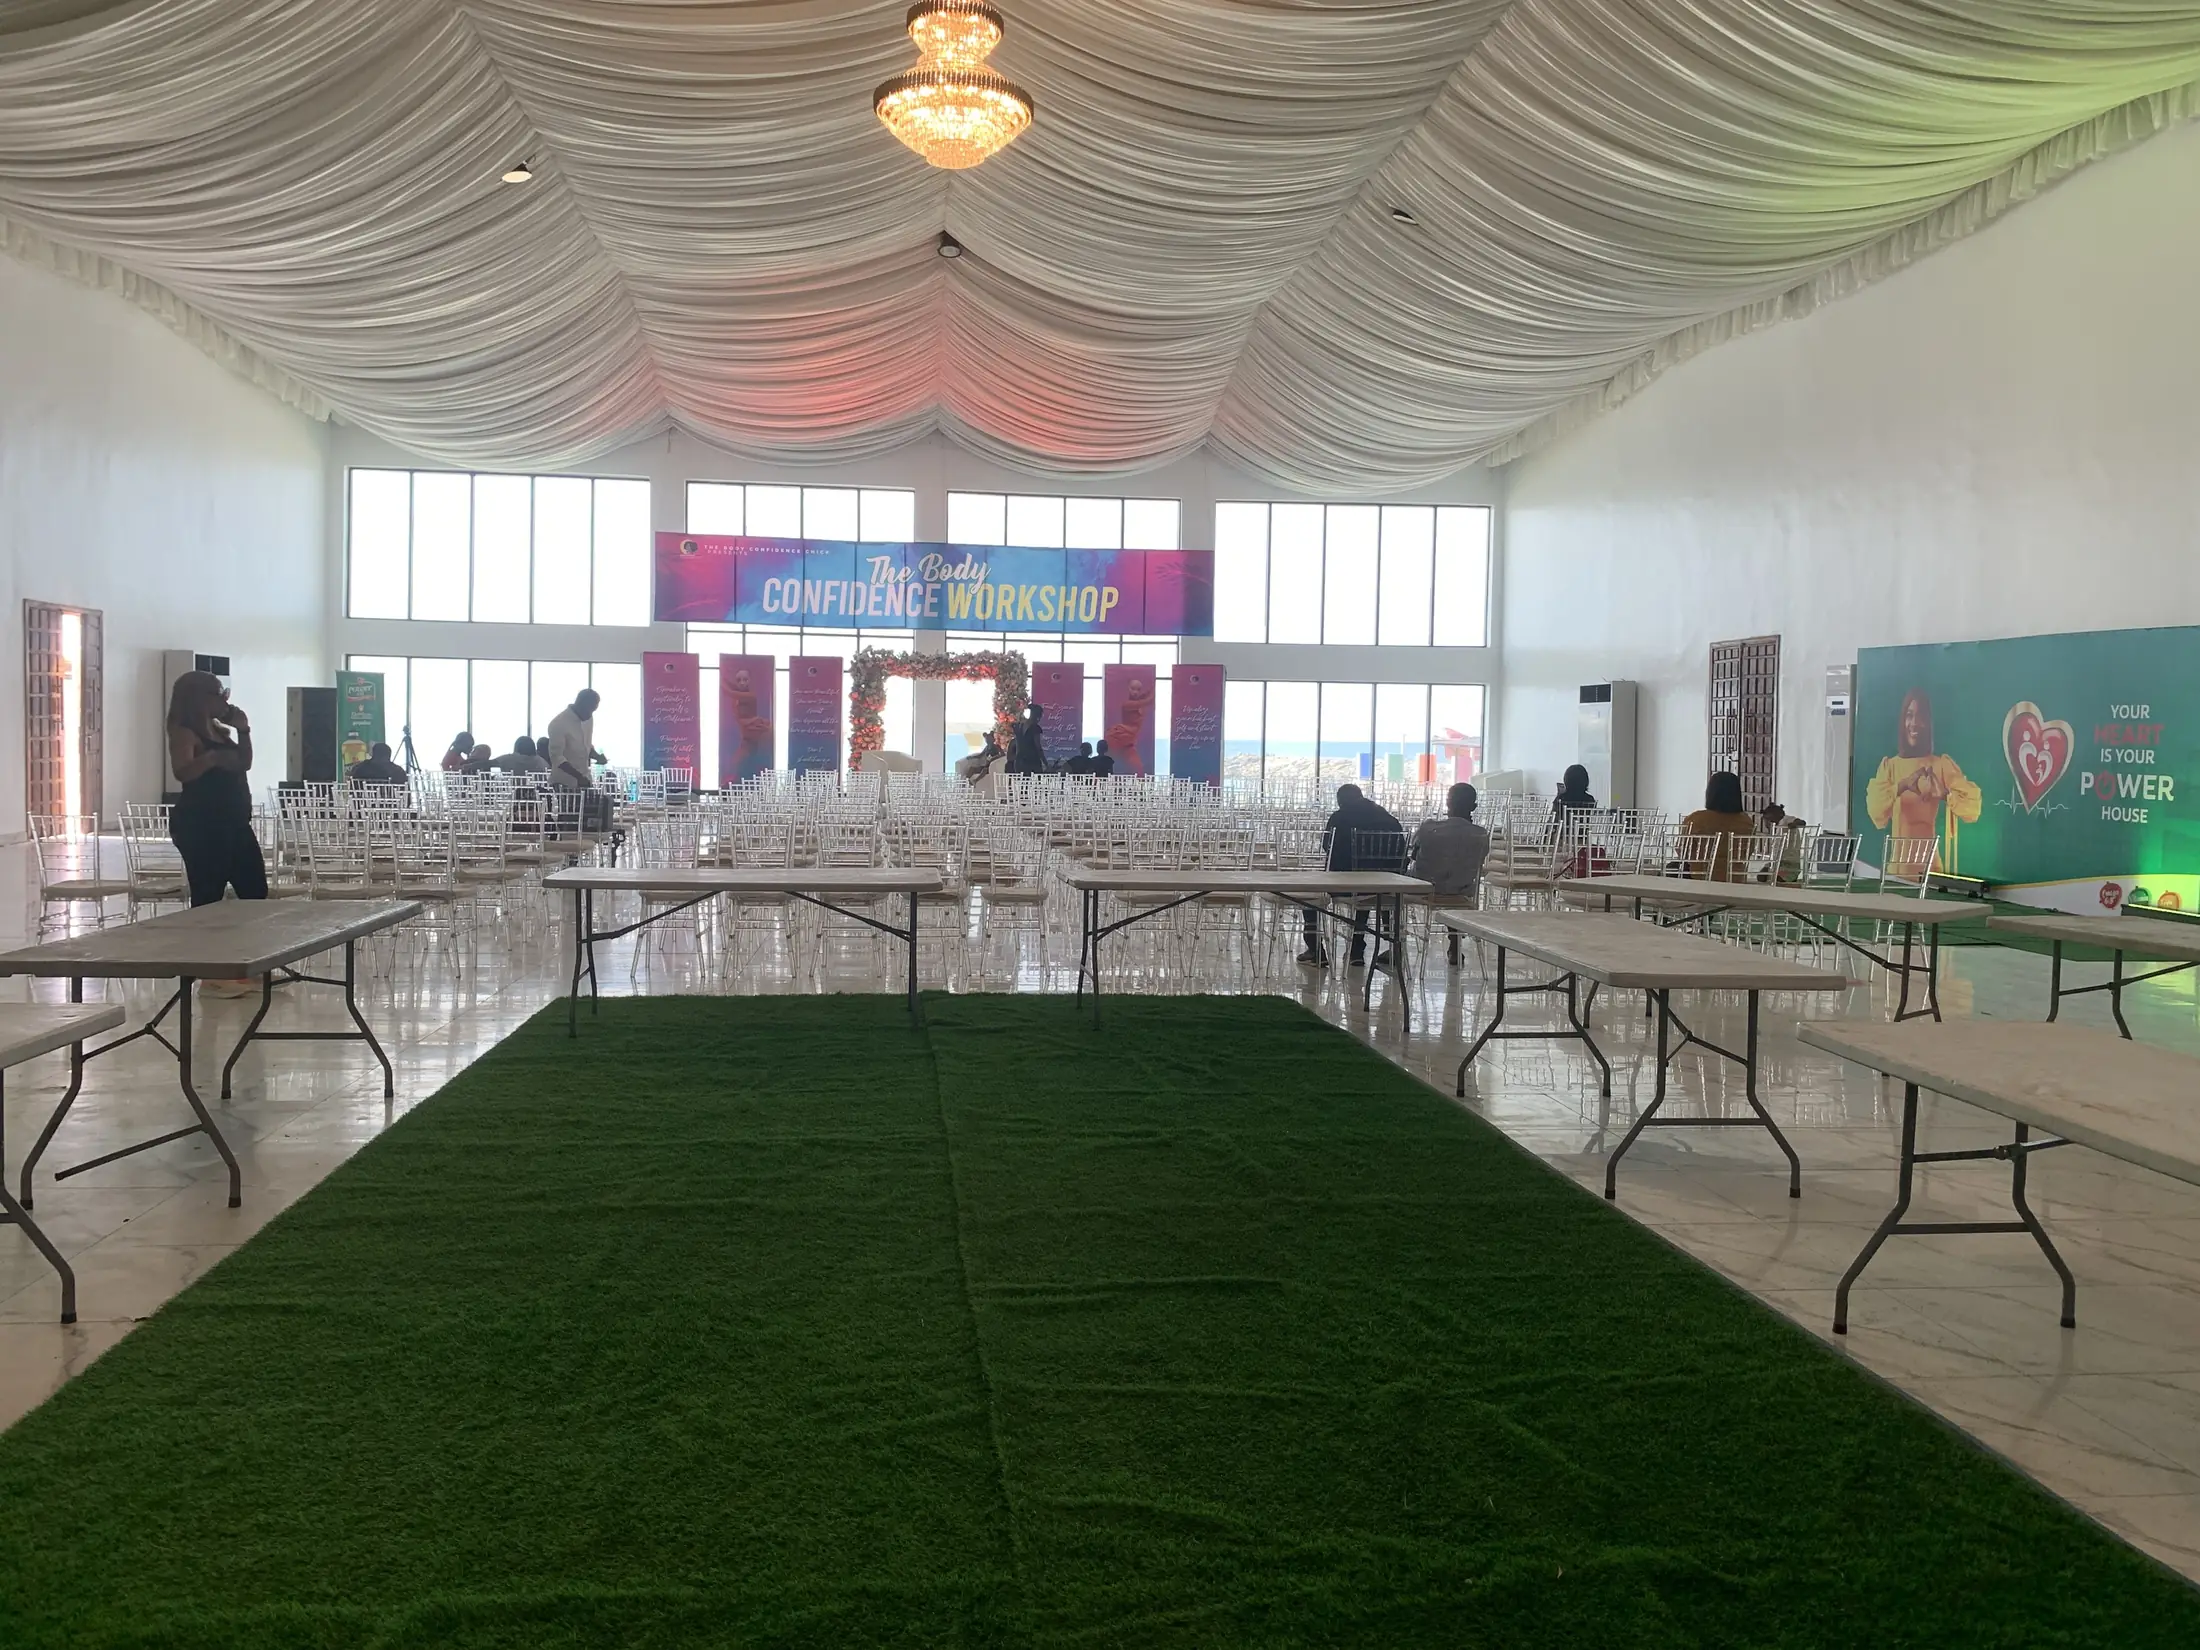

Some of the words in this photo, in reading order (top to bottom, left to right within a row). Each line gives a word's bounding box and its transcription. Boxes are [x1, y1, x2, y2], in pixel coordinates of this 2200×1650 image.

[749, 546, 801, 554] CONFIDENCE
[866, 555, 916, 585] The
[918, 552, 991, 594] Body
[762, 577, 942, 618] CONFIDENCE
[947, 582, 1120, 623] WORKSHOP
[2110, 704, 2150, 719] YOUR
[2094, 723, 2166, 745] HEART
[2100, 748, 2112, 762] IS
[2116, 749, 2155, 764] YOUR
[2080, 770, 2174, 802] POWER
[2102, 806, 2149, 824] HOUSE
